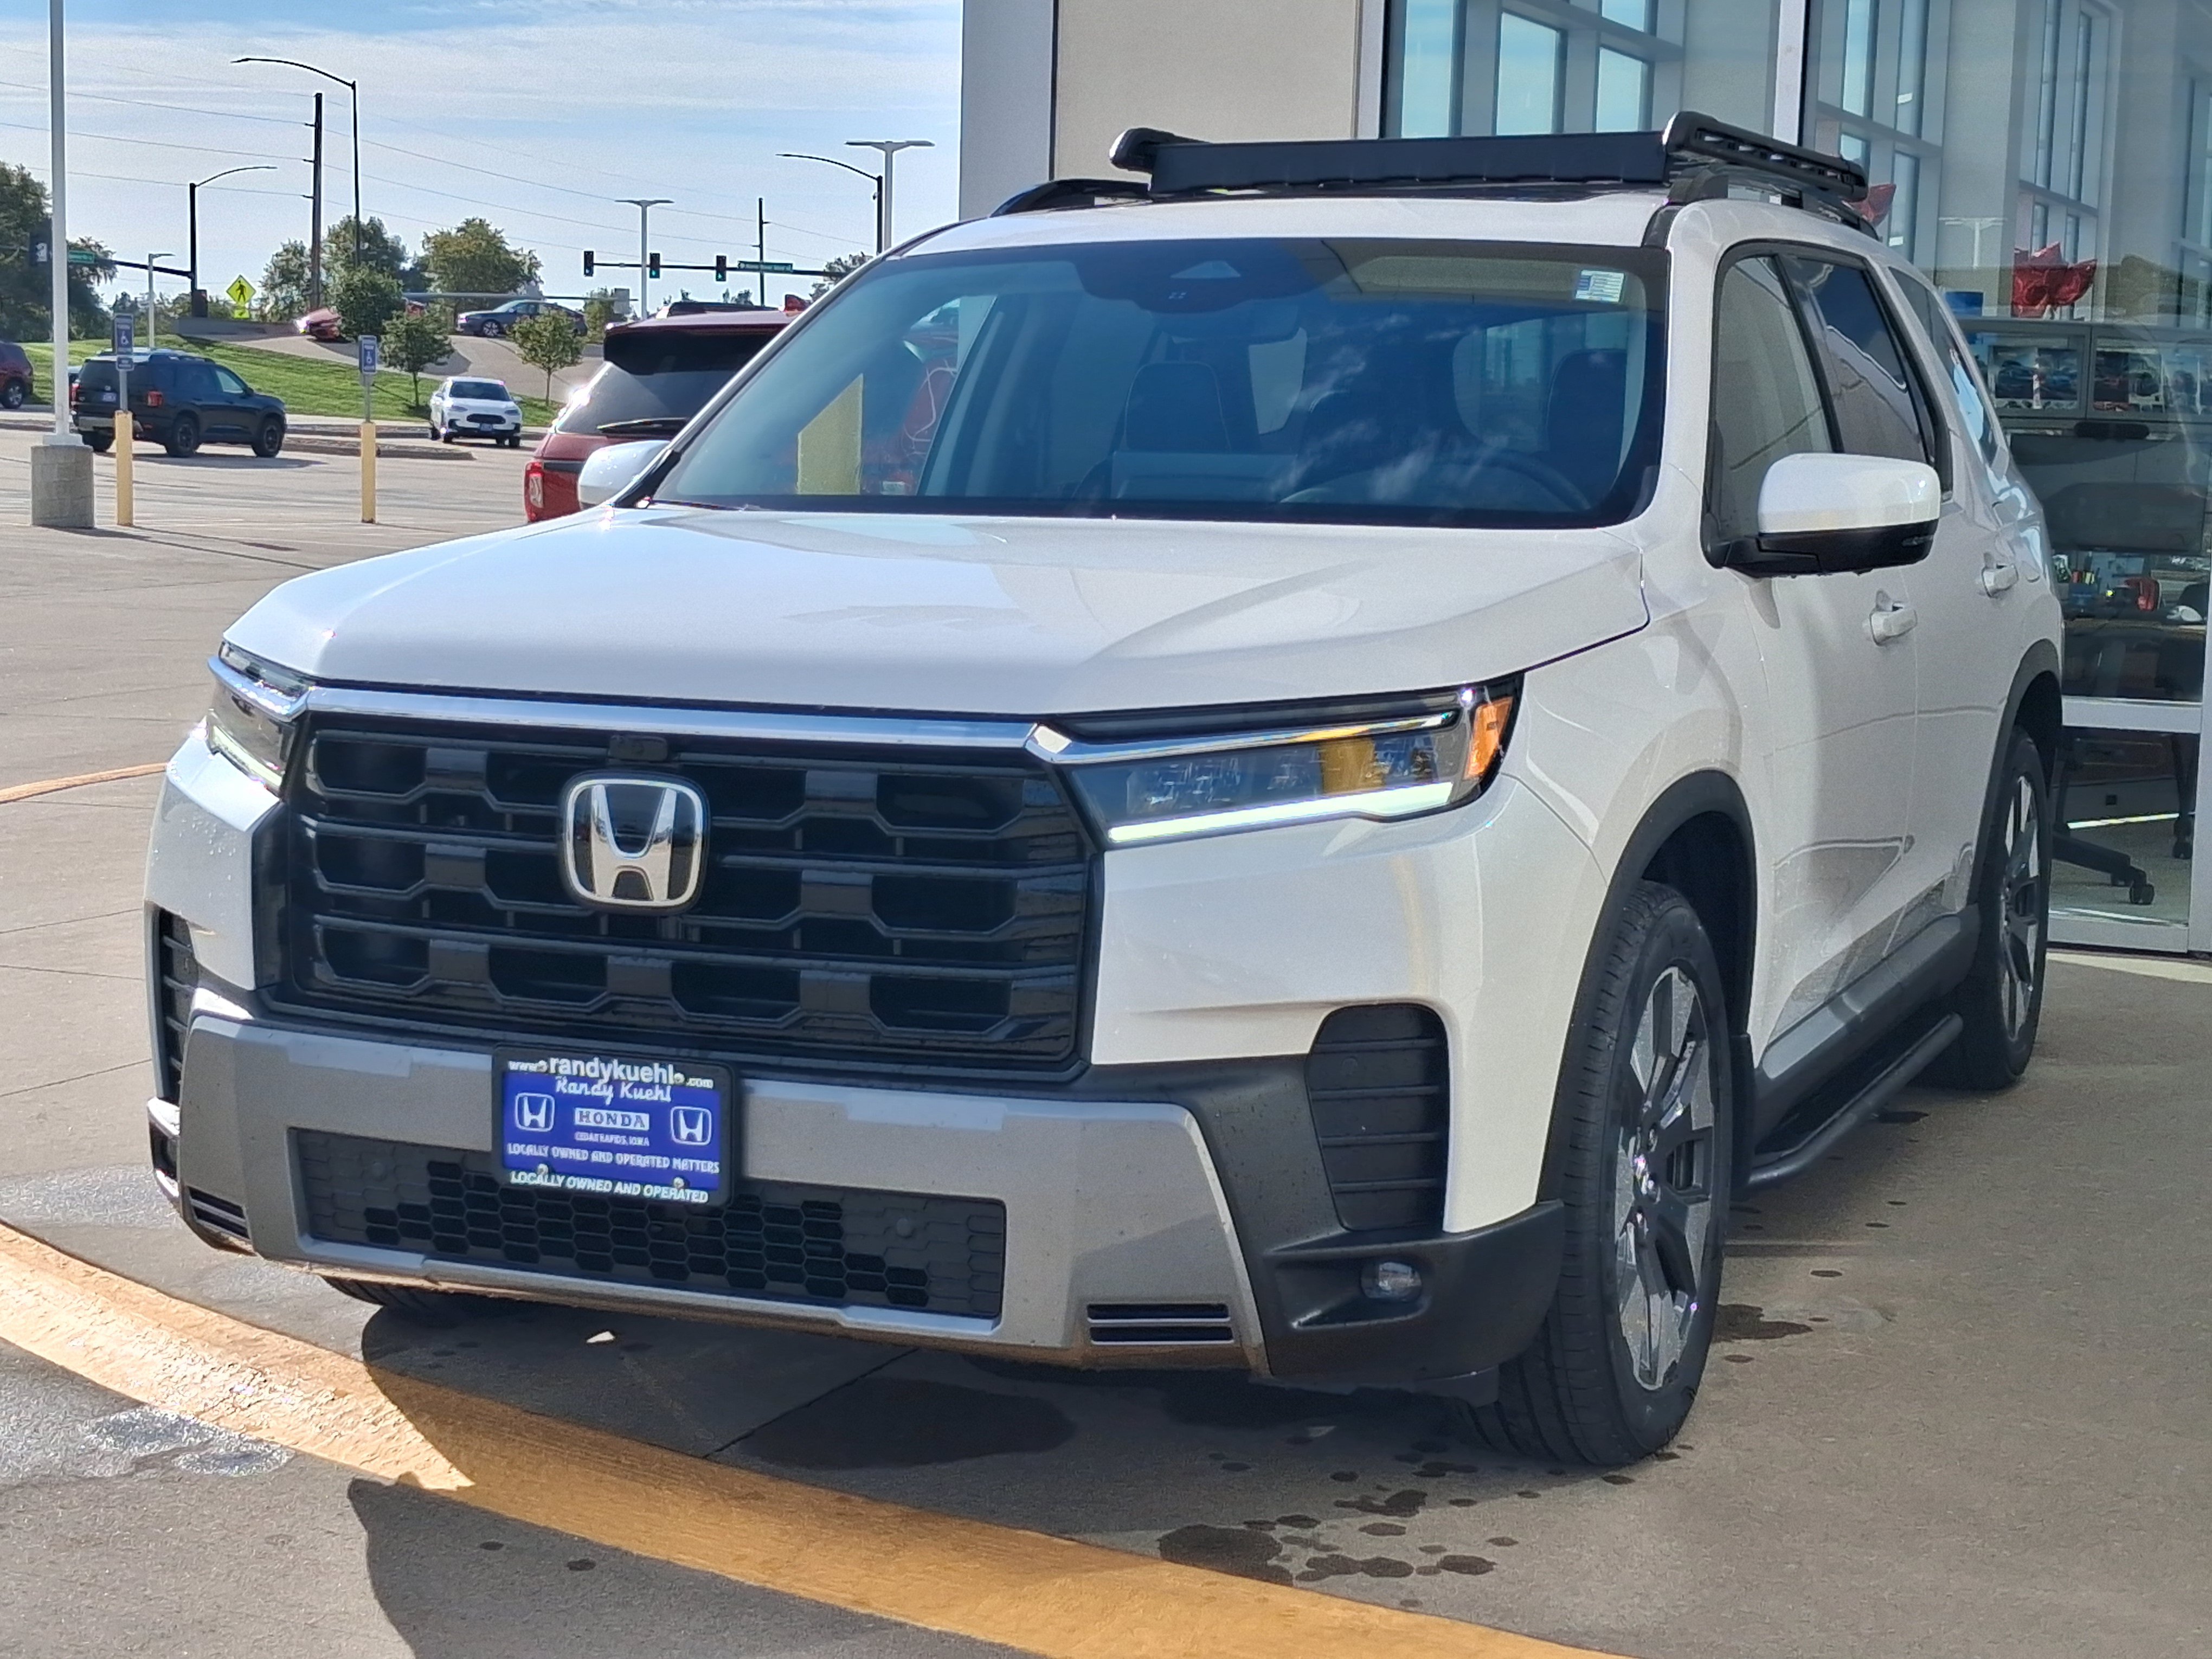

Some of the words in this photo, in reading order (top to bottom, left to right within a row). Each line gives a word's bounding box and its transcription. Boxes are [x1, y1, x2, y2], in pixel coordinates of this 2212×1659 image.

[556, 1076, 614, 1106] Randy
[619, 1082, 672, 1102] Kuehl
[578, 1110, 646, 1129] HONDA
[507, 1142, 549, 1157] LOCALLY
[551, 1146, 589, 1161] OWNED
[591, 1150, 613, 1163] AND
[615, 1153, 670, 1168] OPERATED
[672, 1158, 720, 1173] MATTERS
[510, 1171, 566, 1187] LOCALLY
[567, 1175, 613, 1193] OWNED
[614, 1181, 641, 1195] AND
[643, 1184, 709, 1204] OPERATED
